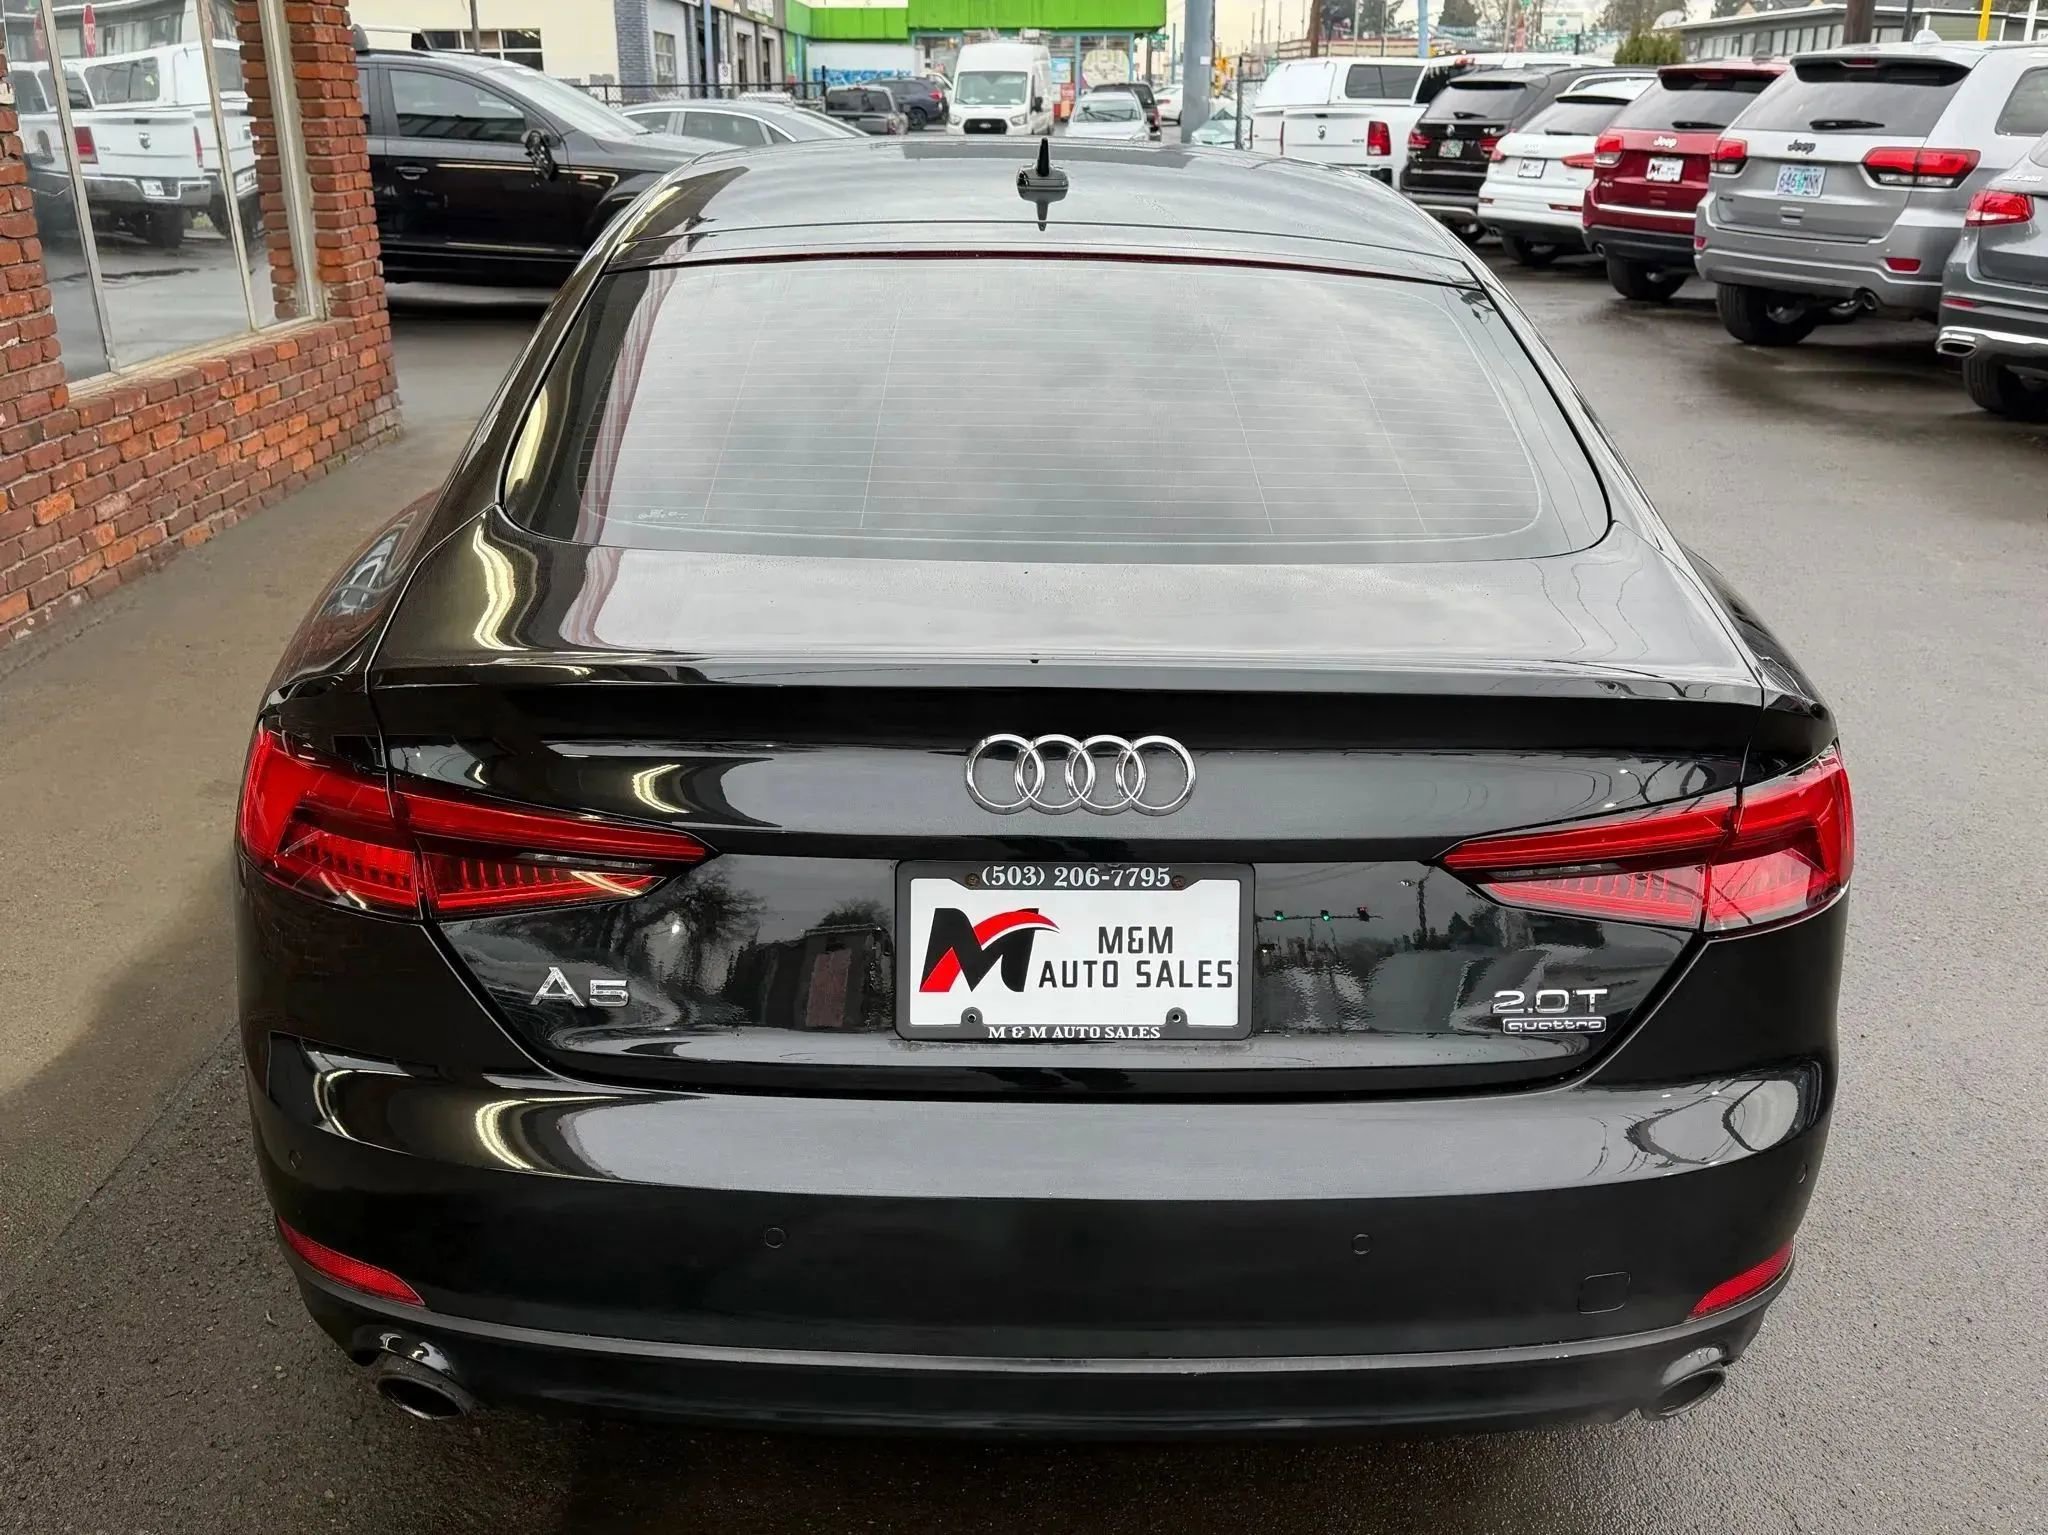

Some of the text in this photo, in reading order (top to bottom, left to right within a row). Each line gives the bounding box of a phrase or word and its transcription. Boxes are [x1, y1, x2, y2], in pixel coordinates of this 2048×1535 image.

[1653, 136, 1678, 148] Jeep
[1787, 139, 1816, 155] Jeep
[981, 865, 1171, 888] (503) 206-7795
[1098, 926, 1174, 954] M&M
[1038, 960, 1233, 988] AUTO SALES
[531, 966, 630, 1008] A5
[1492, 988, 1608, 1014] 2.0T
[988, 1026, 1161, 1039] M & M AUTO SALES
[1507, 1020, 1602, 1032] quattro
